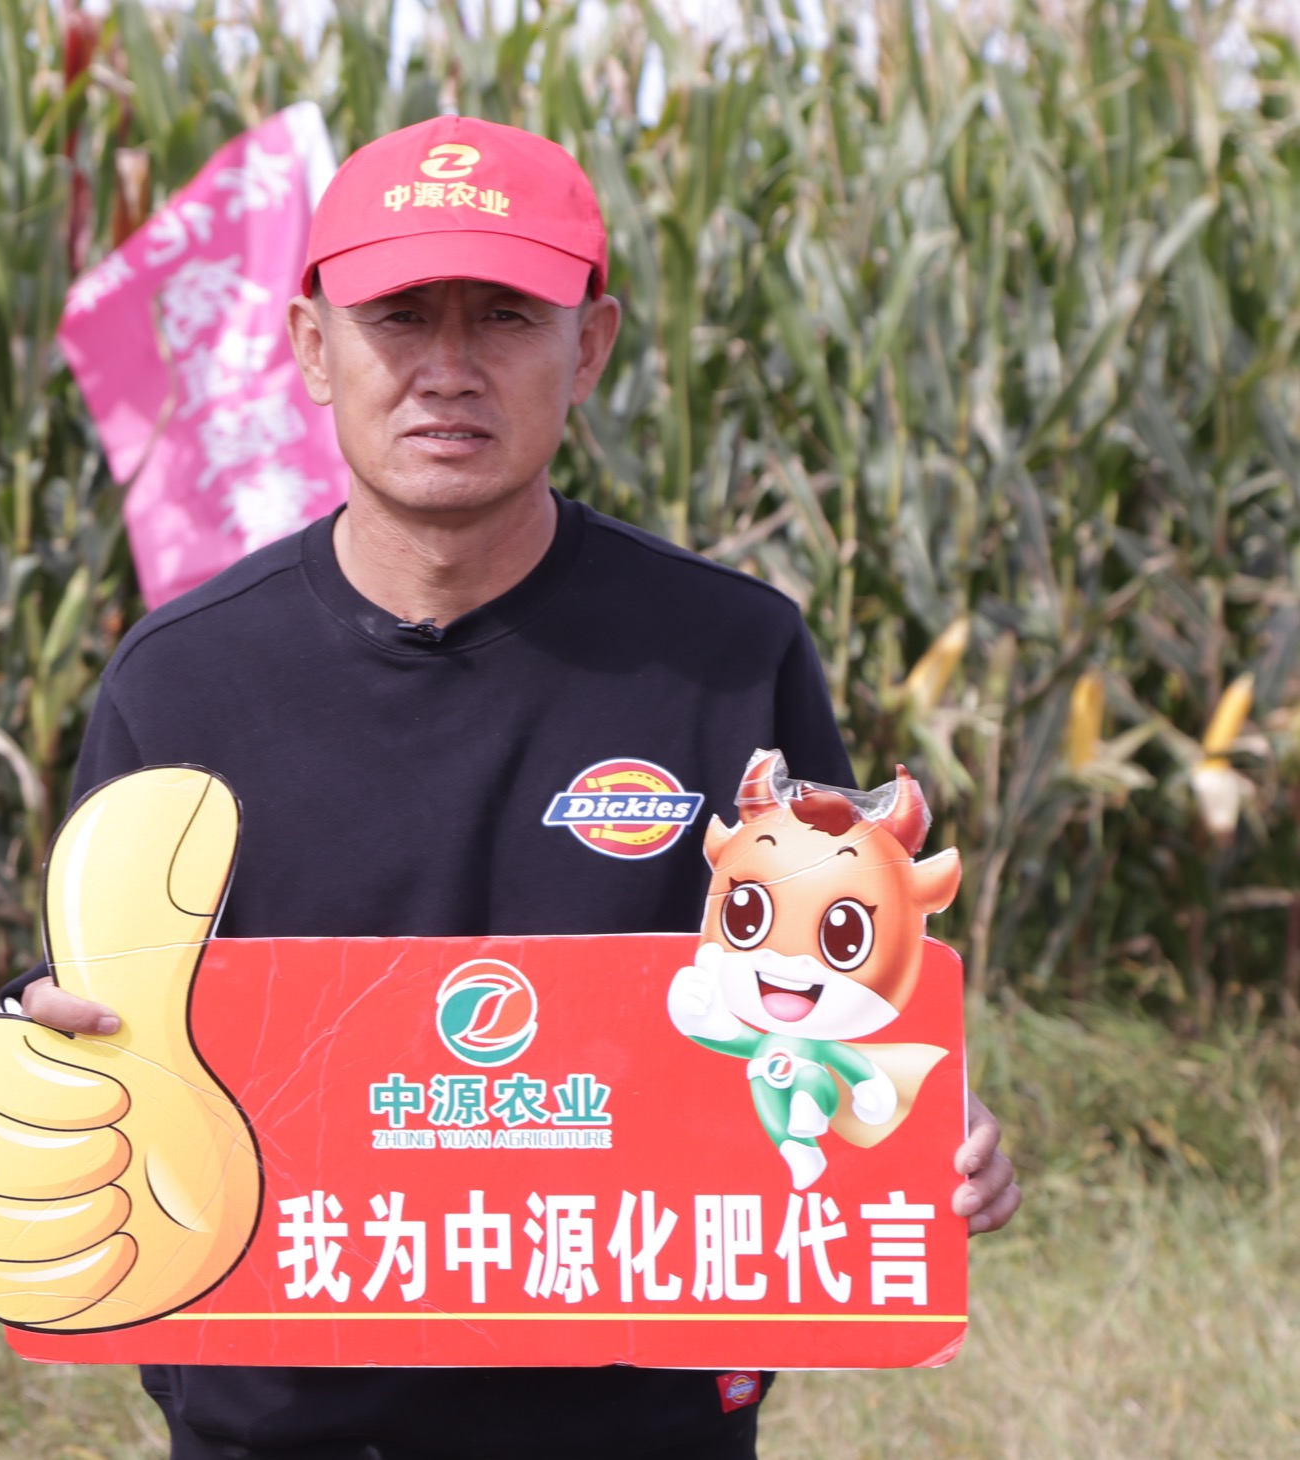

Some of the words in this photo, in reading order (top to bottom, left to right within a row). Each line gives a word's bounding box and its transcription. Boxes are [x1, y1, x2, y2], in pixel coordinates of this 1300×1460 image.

[383, 180, 511, 217] 中源农业
[562, 796, 693, 819] Dickies
[369, 1072, 613, 1129] 中源农业
[373, 1130, 436, 1149] ZHONG
[438, 1130, 491, 1149] YUAN
[276, 1188, 936, 1306] 我为中源化肥代言
